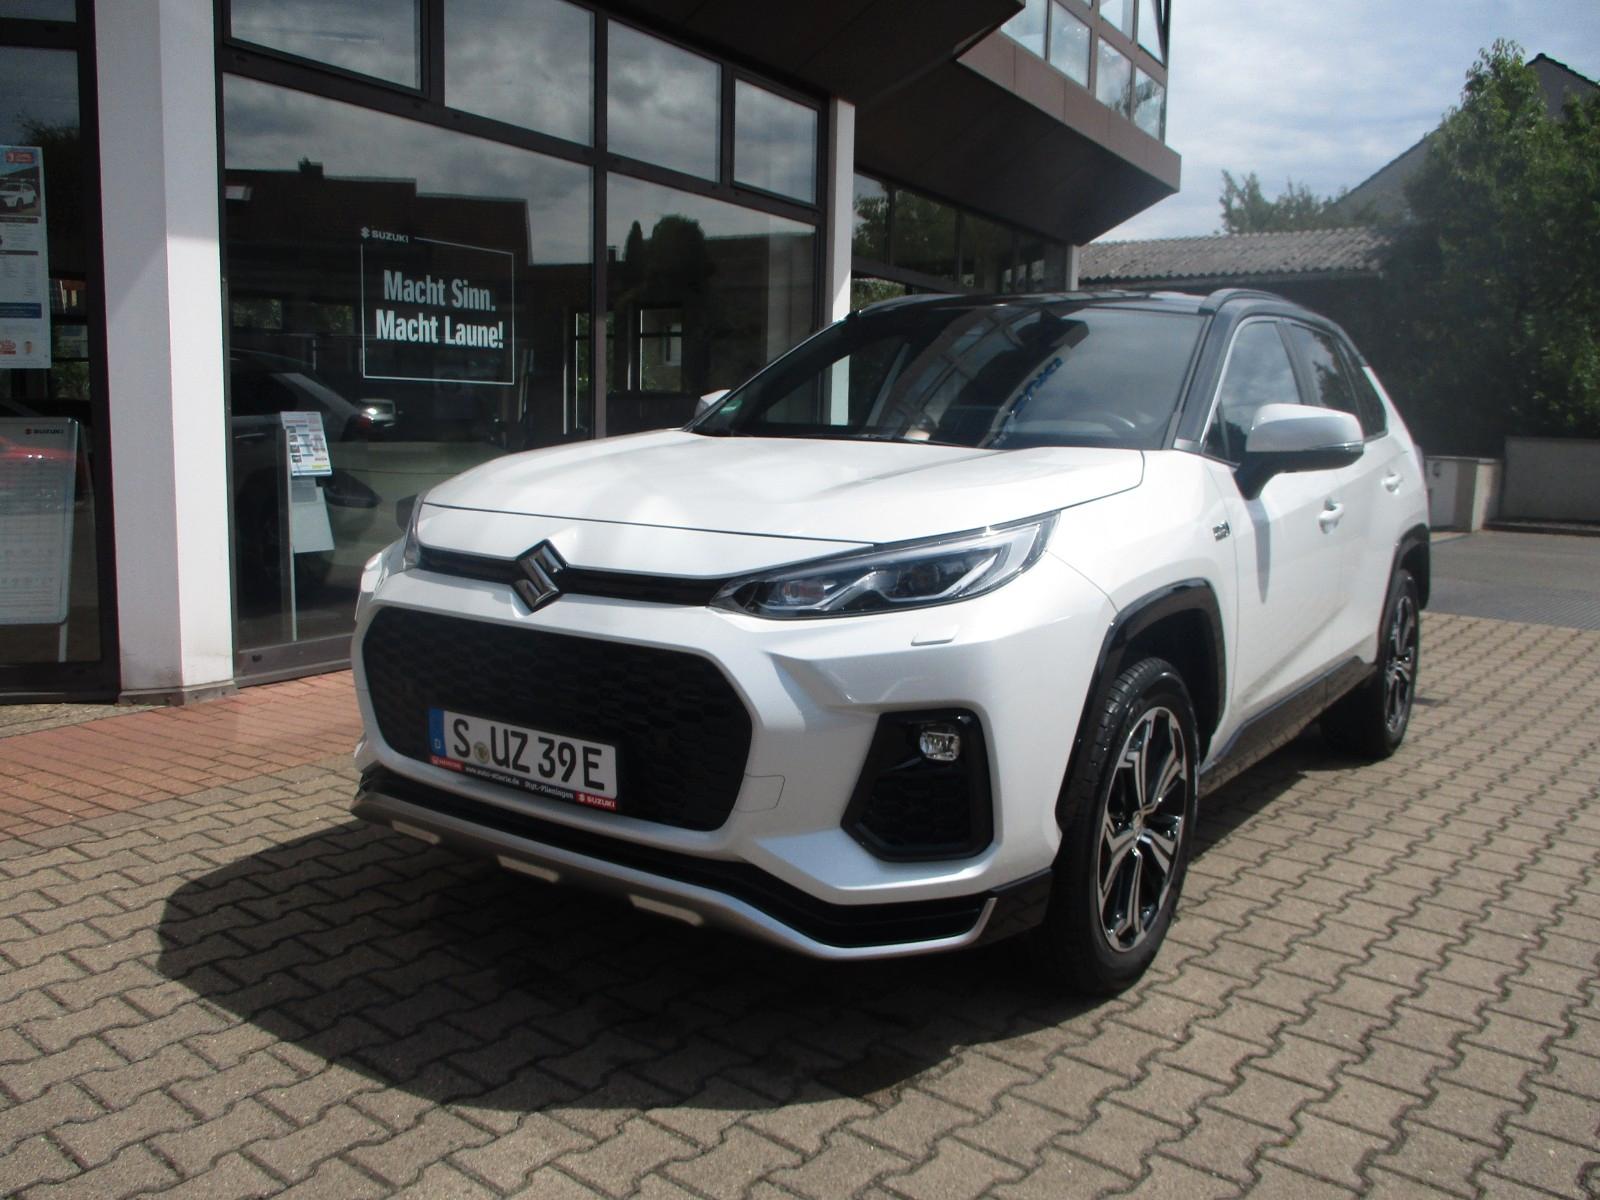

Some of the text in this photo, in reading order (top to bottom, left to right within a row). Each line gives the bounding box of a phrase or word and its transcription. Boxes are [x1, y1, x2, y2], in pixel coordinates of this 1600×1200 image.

[371, 229, 409, 243] SUZUKI
[383, 269, 497, 311] Macht Sinn.
[375, 308, 504, 349] Macht Laune!
[453, 718, 471, 758] S
[490, 725, 531, 774] UZ
[586, 795, 616, 808] SUZUKI
